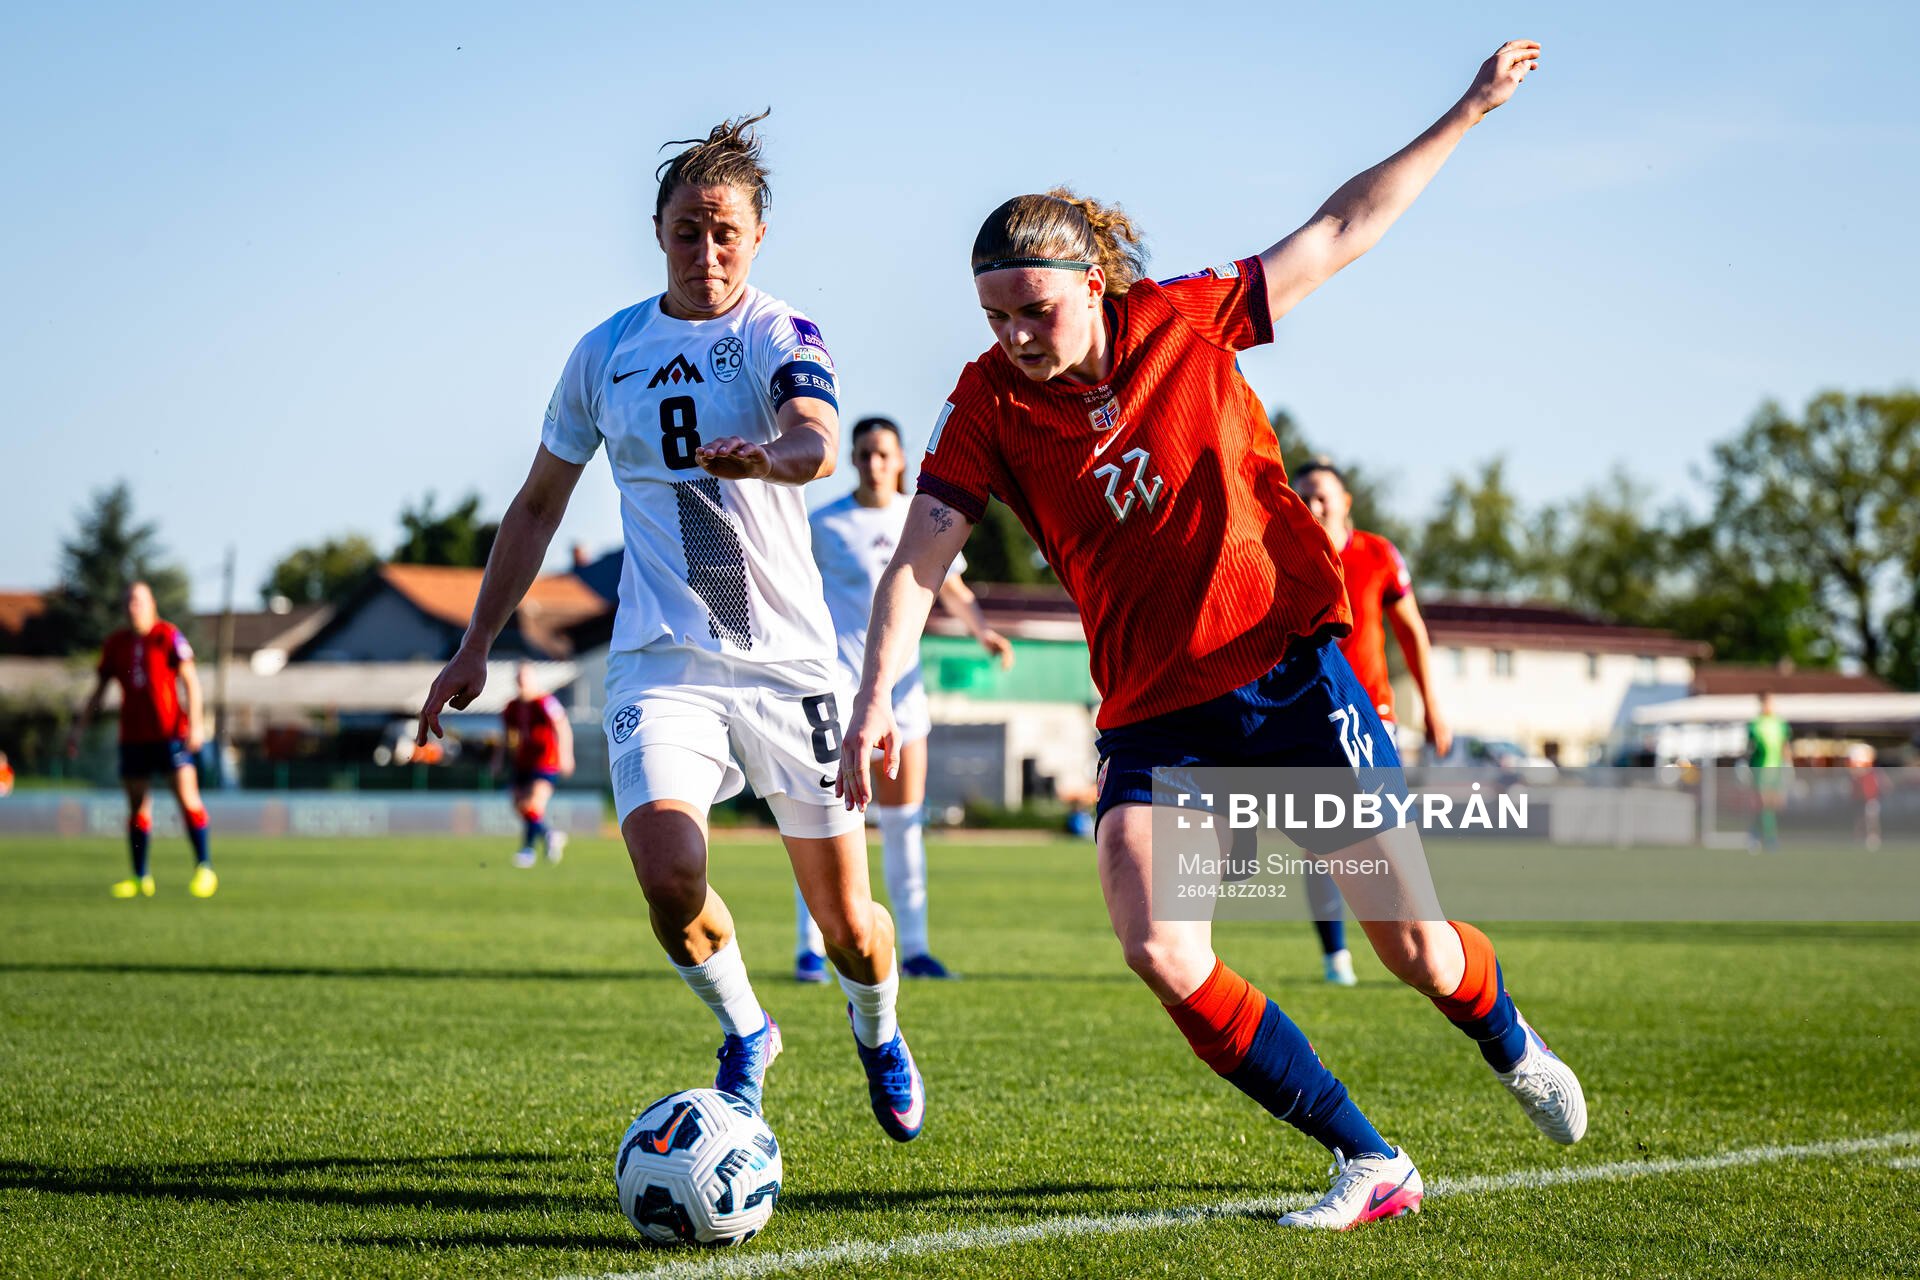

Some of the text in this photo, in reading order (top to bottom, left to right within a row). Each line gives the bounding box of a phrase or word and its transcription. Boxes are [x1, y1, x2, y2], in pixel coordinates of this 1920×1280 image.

[659, 395, 701, 470] 8
[1093, 447, 1163, 524] 22
[802, 691, 843, 764] 8
[1327, 703, 1375, 778] 22
